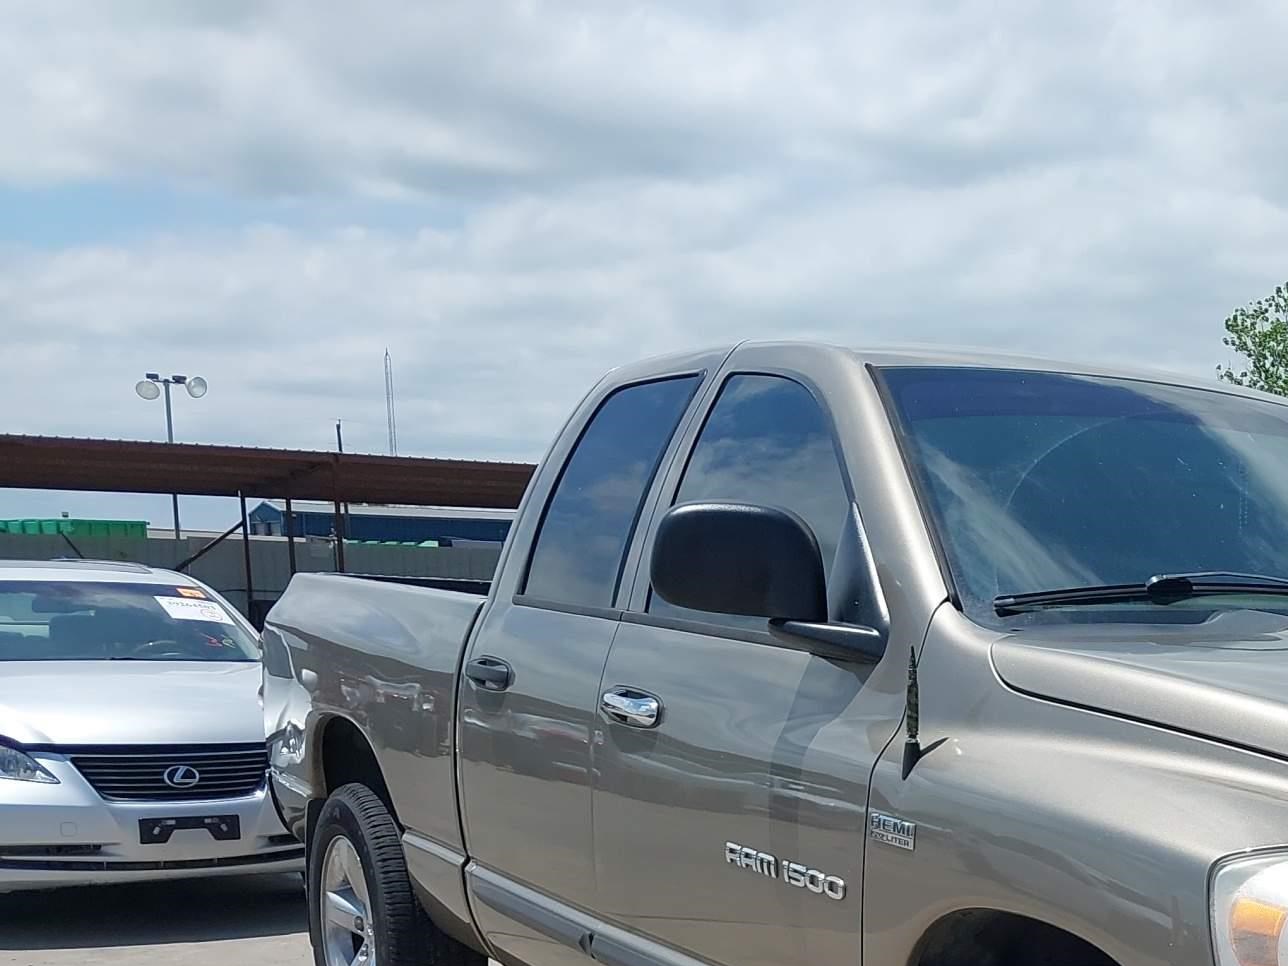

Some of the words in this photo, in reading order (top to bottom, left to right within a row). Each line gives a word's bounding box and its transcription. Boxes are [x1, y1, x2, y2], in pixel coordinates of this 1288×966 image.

[871, 814, 911, 838] HEMI
[886, 834, 910, 848] LITER
[725, 841, 778, 879] RAM
[782, 859, 846, 900] 1500
